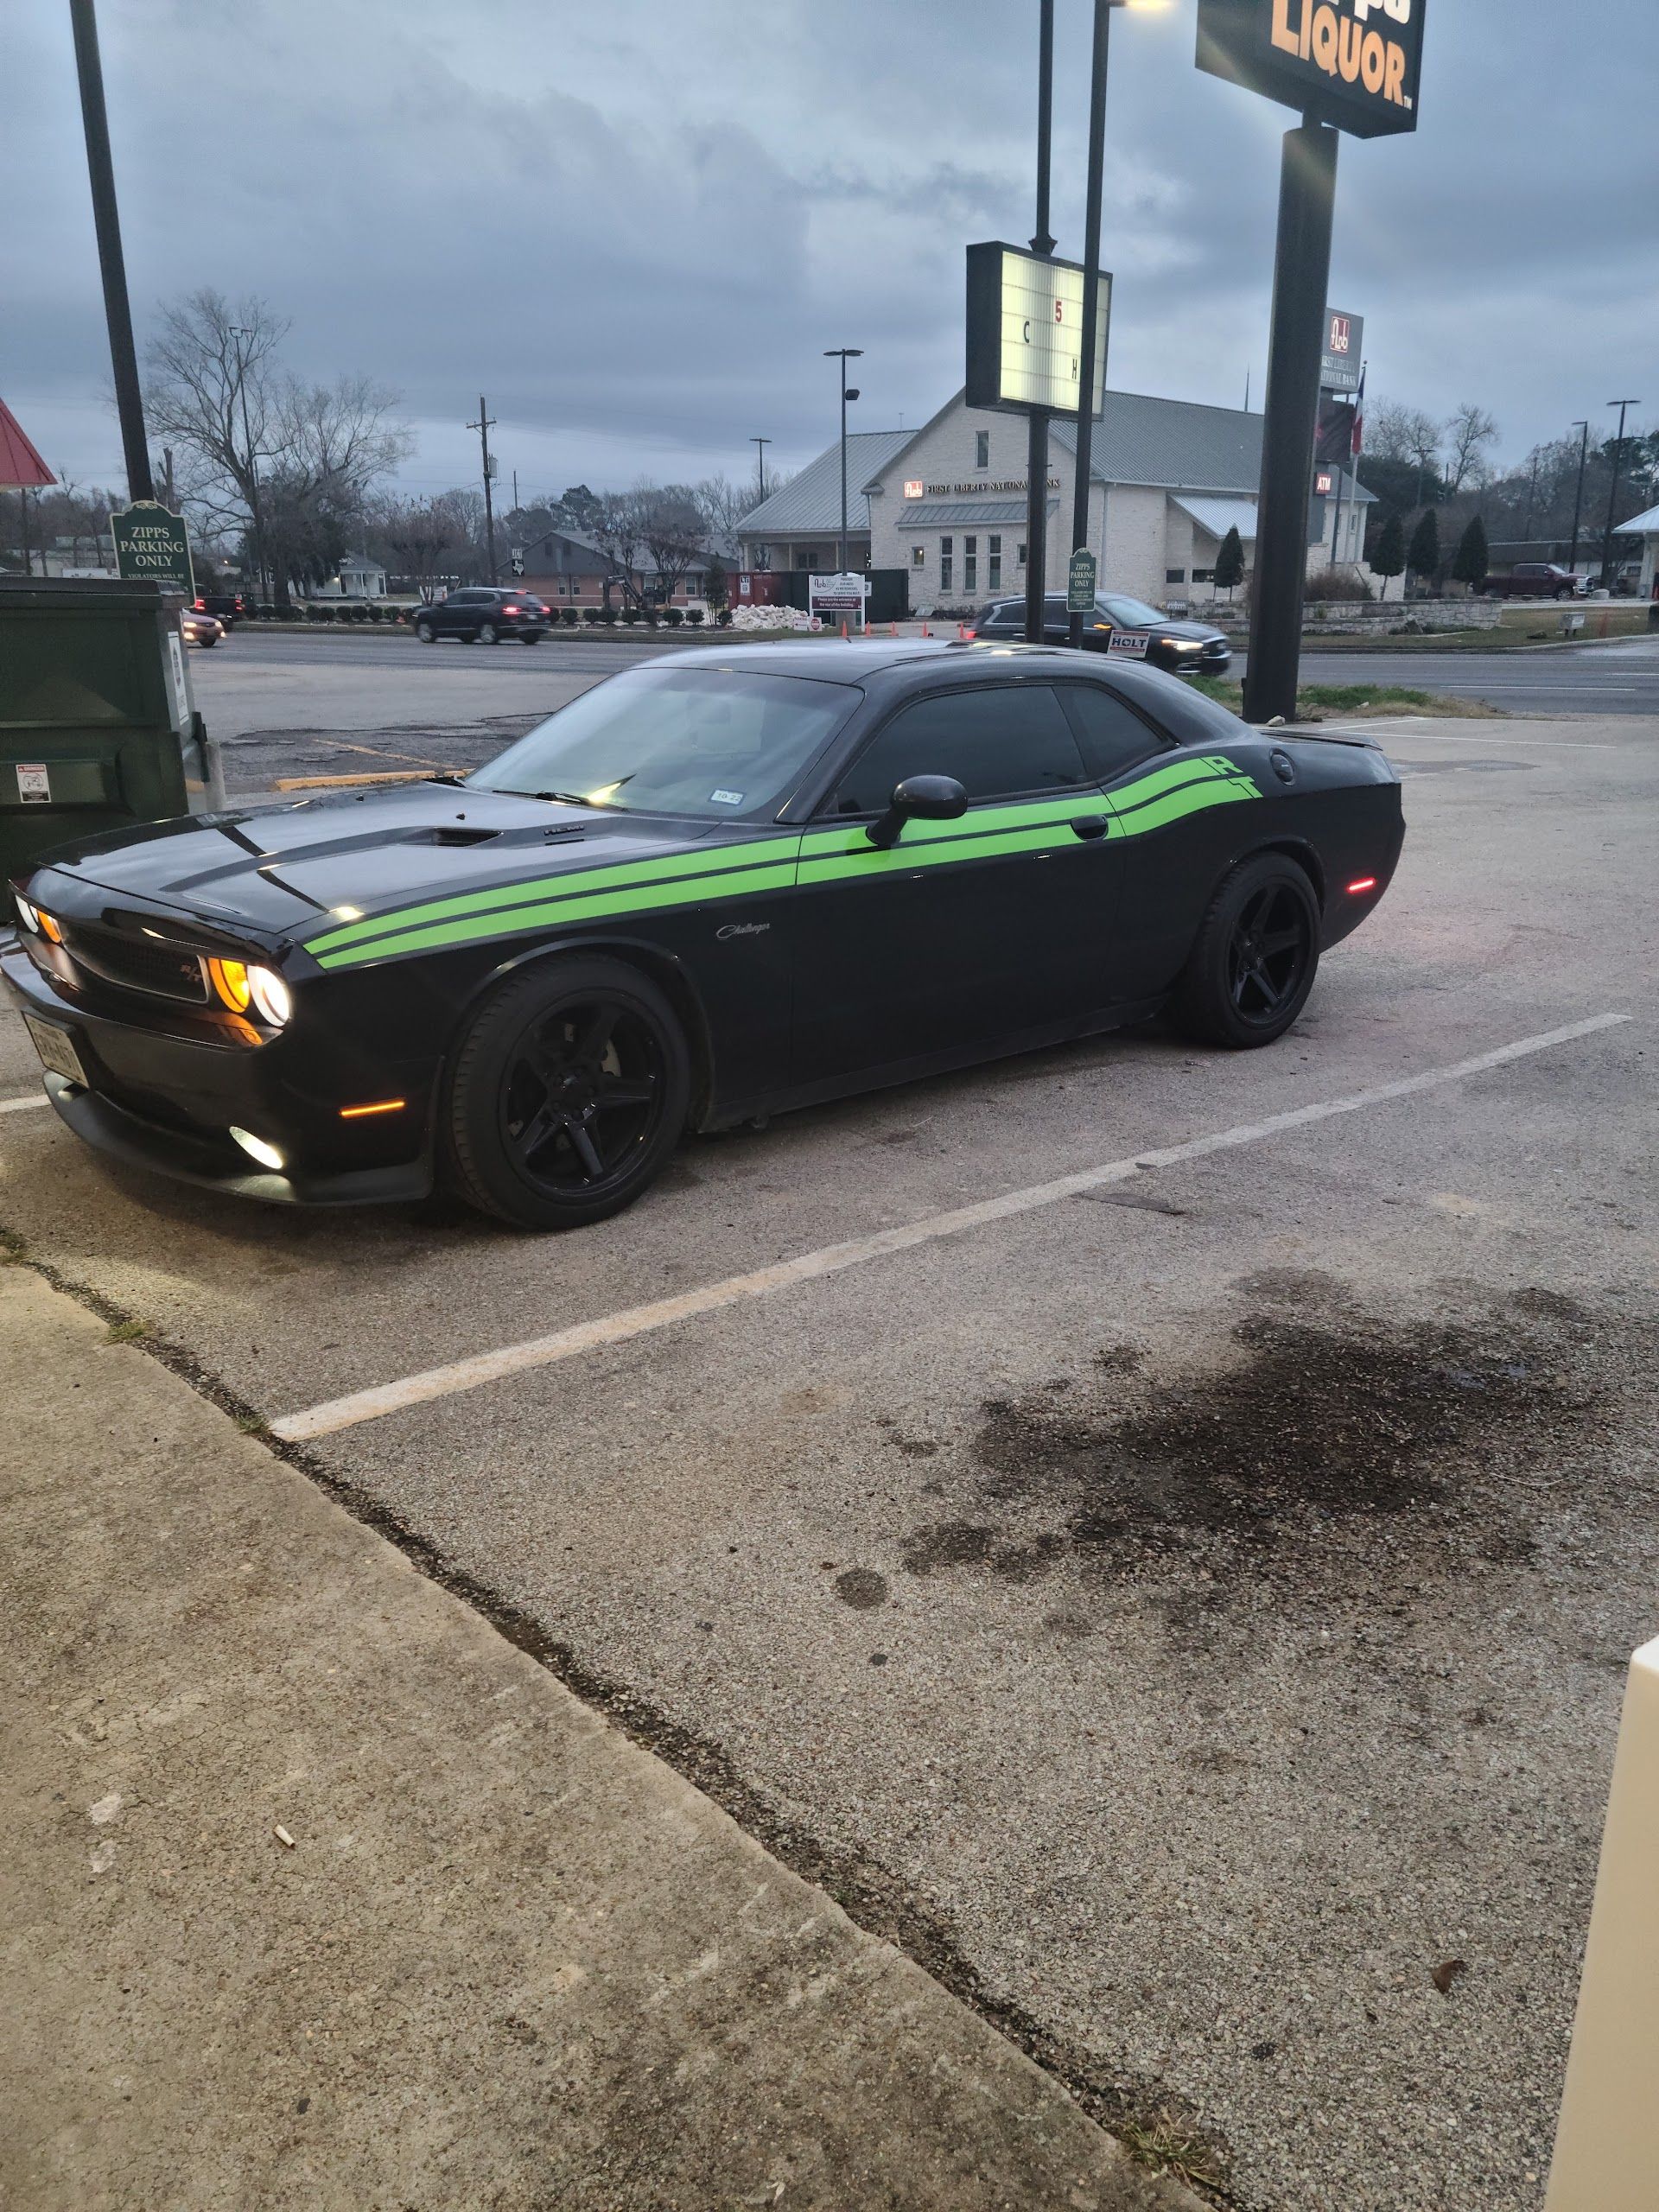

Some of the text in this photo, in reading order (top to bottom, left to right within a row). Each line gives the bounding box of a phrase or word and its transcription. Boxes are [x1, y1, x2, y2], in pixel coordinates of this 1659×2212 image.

[1271, 0, 1405, 106] LIQUOR
[1055, 301, 1062, 322] 5
[1023, 321, 1030, 343] C
[1071, 358, 1077, 380] H
[952, 482, 986, 492] LIBERTY
[990, 480, 1027, 490] NATIONA
[1317, 477, 1331, 491] ATM
[131, 526, 170, 538] ZIPPS
[120, 541, 184, 553] PARKING
[135, 555, 173, 567] ONLY
[1111, 637, 1147, 647] HOLT
